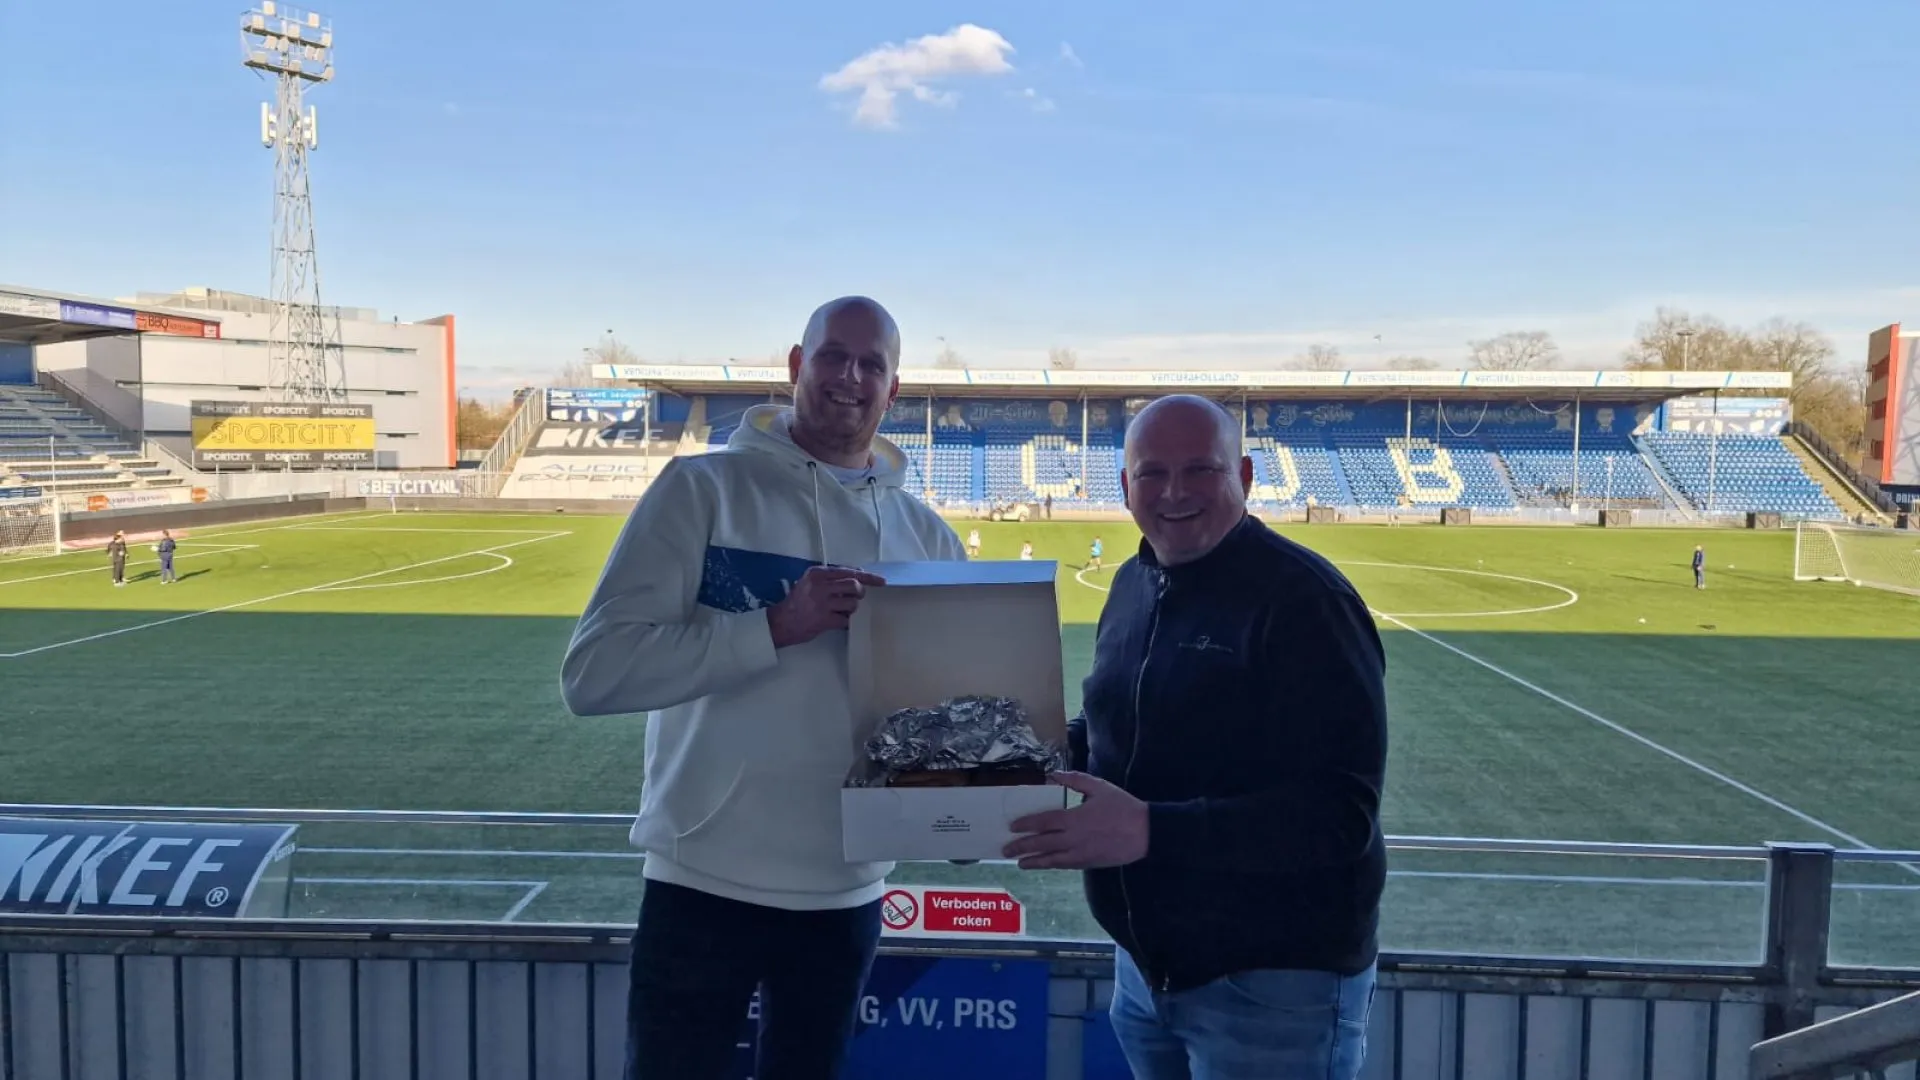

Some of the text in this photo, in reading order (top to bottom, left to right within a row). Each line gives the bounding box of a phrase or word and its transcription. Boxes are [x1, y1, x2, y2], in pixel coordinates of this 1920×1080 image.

[211, 422, 356, 444] SPORTCITY
[932, 896, 1014, 911] Verboden te
[953, 915, 992, 927] roken
[898, 996, 943, 1030] VV,
[953, 997, 1017, 1030] PRS
